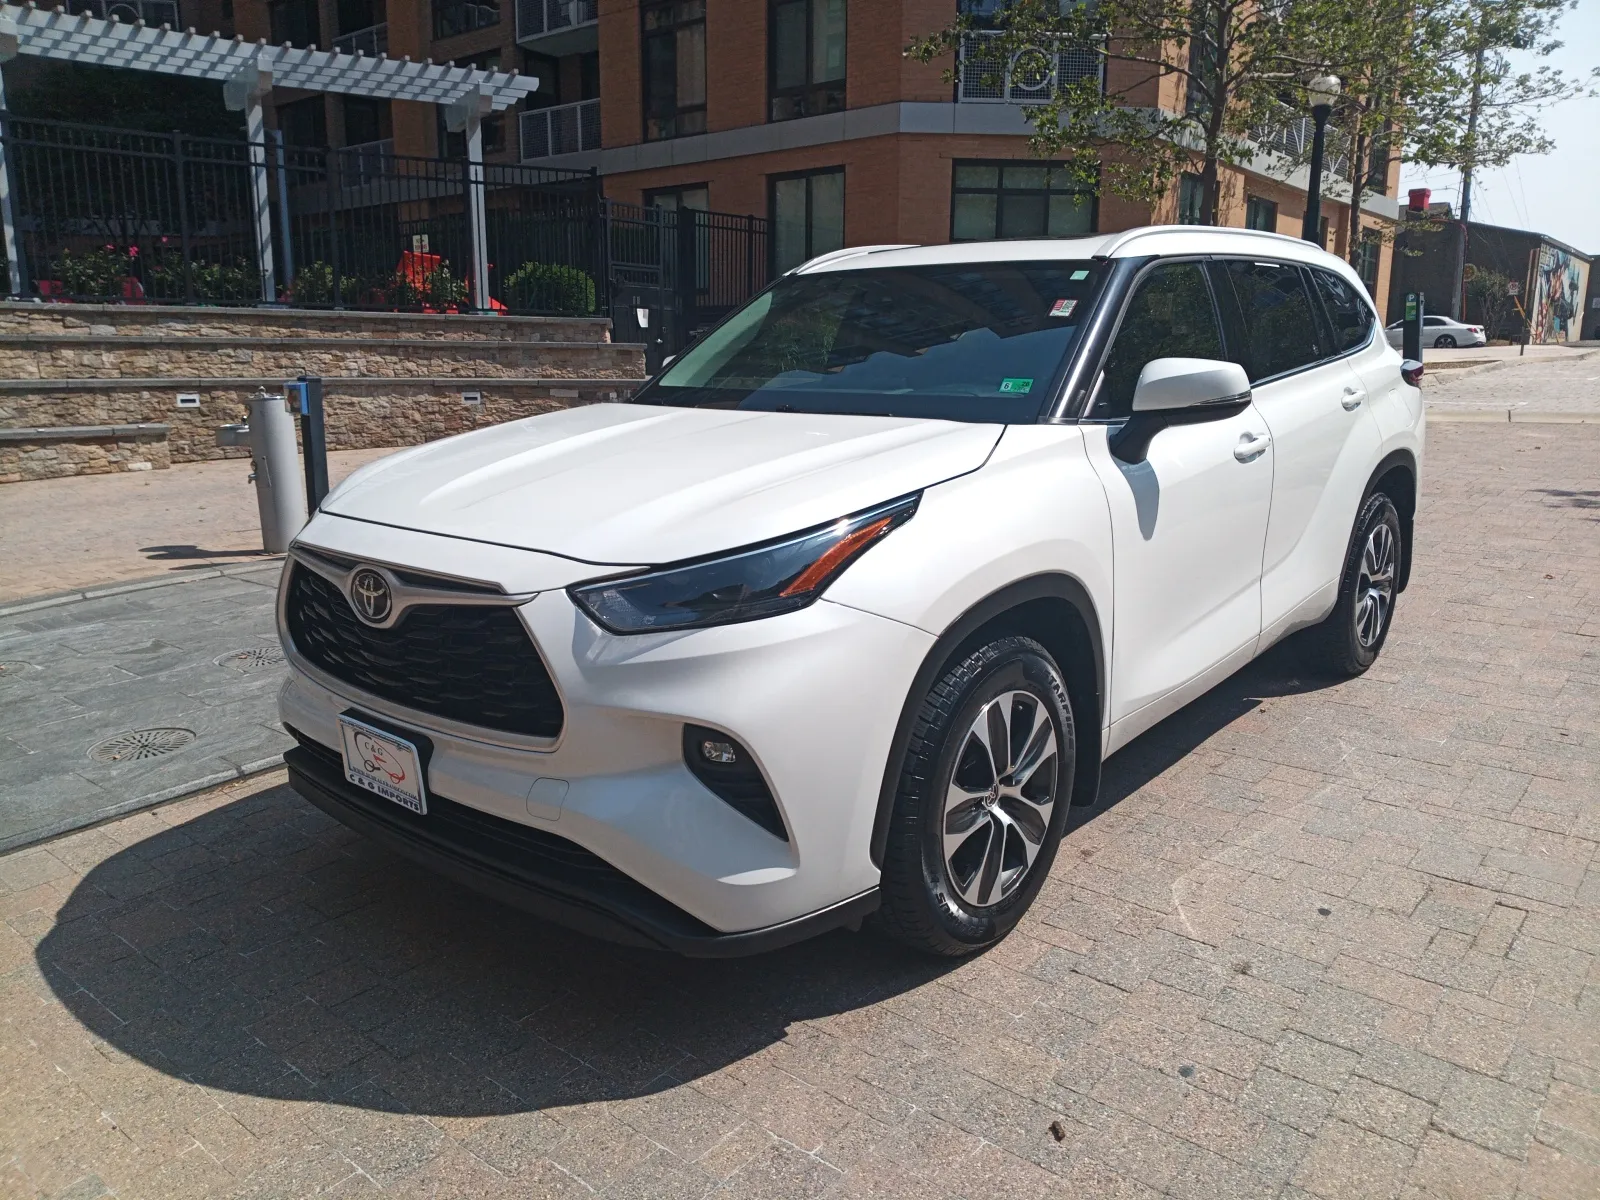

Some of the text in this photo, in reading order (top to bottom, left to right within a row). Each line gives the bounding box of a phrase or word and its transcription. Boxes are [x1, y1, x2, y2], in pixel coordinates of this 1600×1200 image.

[364, 741, 383, 756] C & G
[358, 777, 365, 786] &
[368, 781, 375, 790] G
[377, 786, 420, 811] IMPORTS
